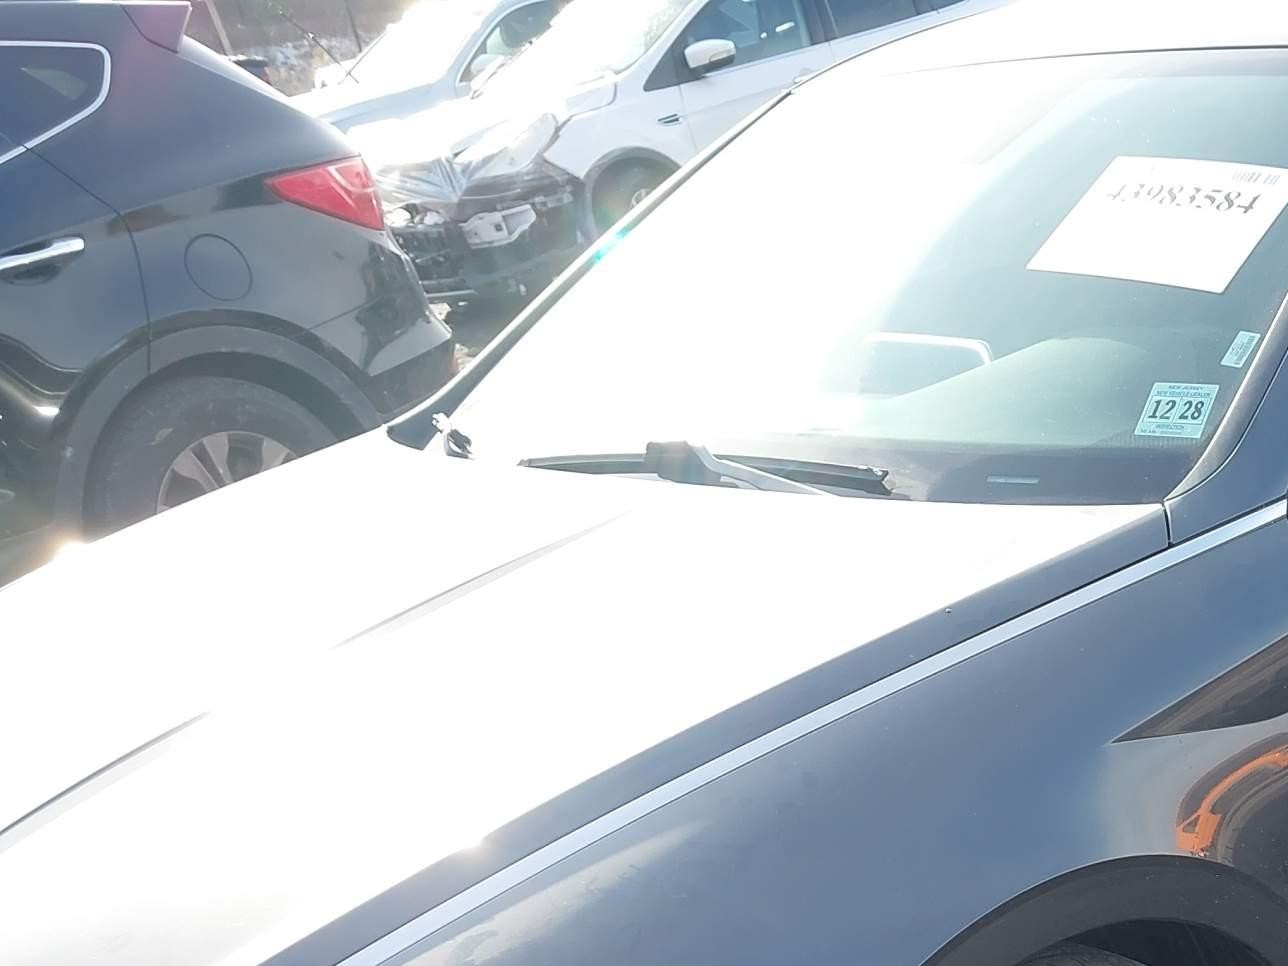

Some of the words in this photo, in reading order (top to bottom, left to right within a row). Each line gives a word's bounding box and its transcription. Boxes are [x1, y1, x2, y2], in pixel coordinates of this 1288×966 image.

[1106, 183, 1263, 214] 43983584
[1147, 399, 1177, 420] 12
[1178, 400, 1205, 420] 28
